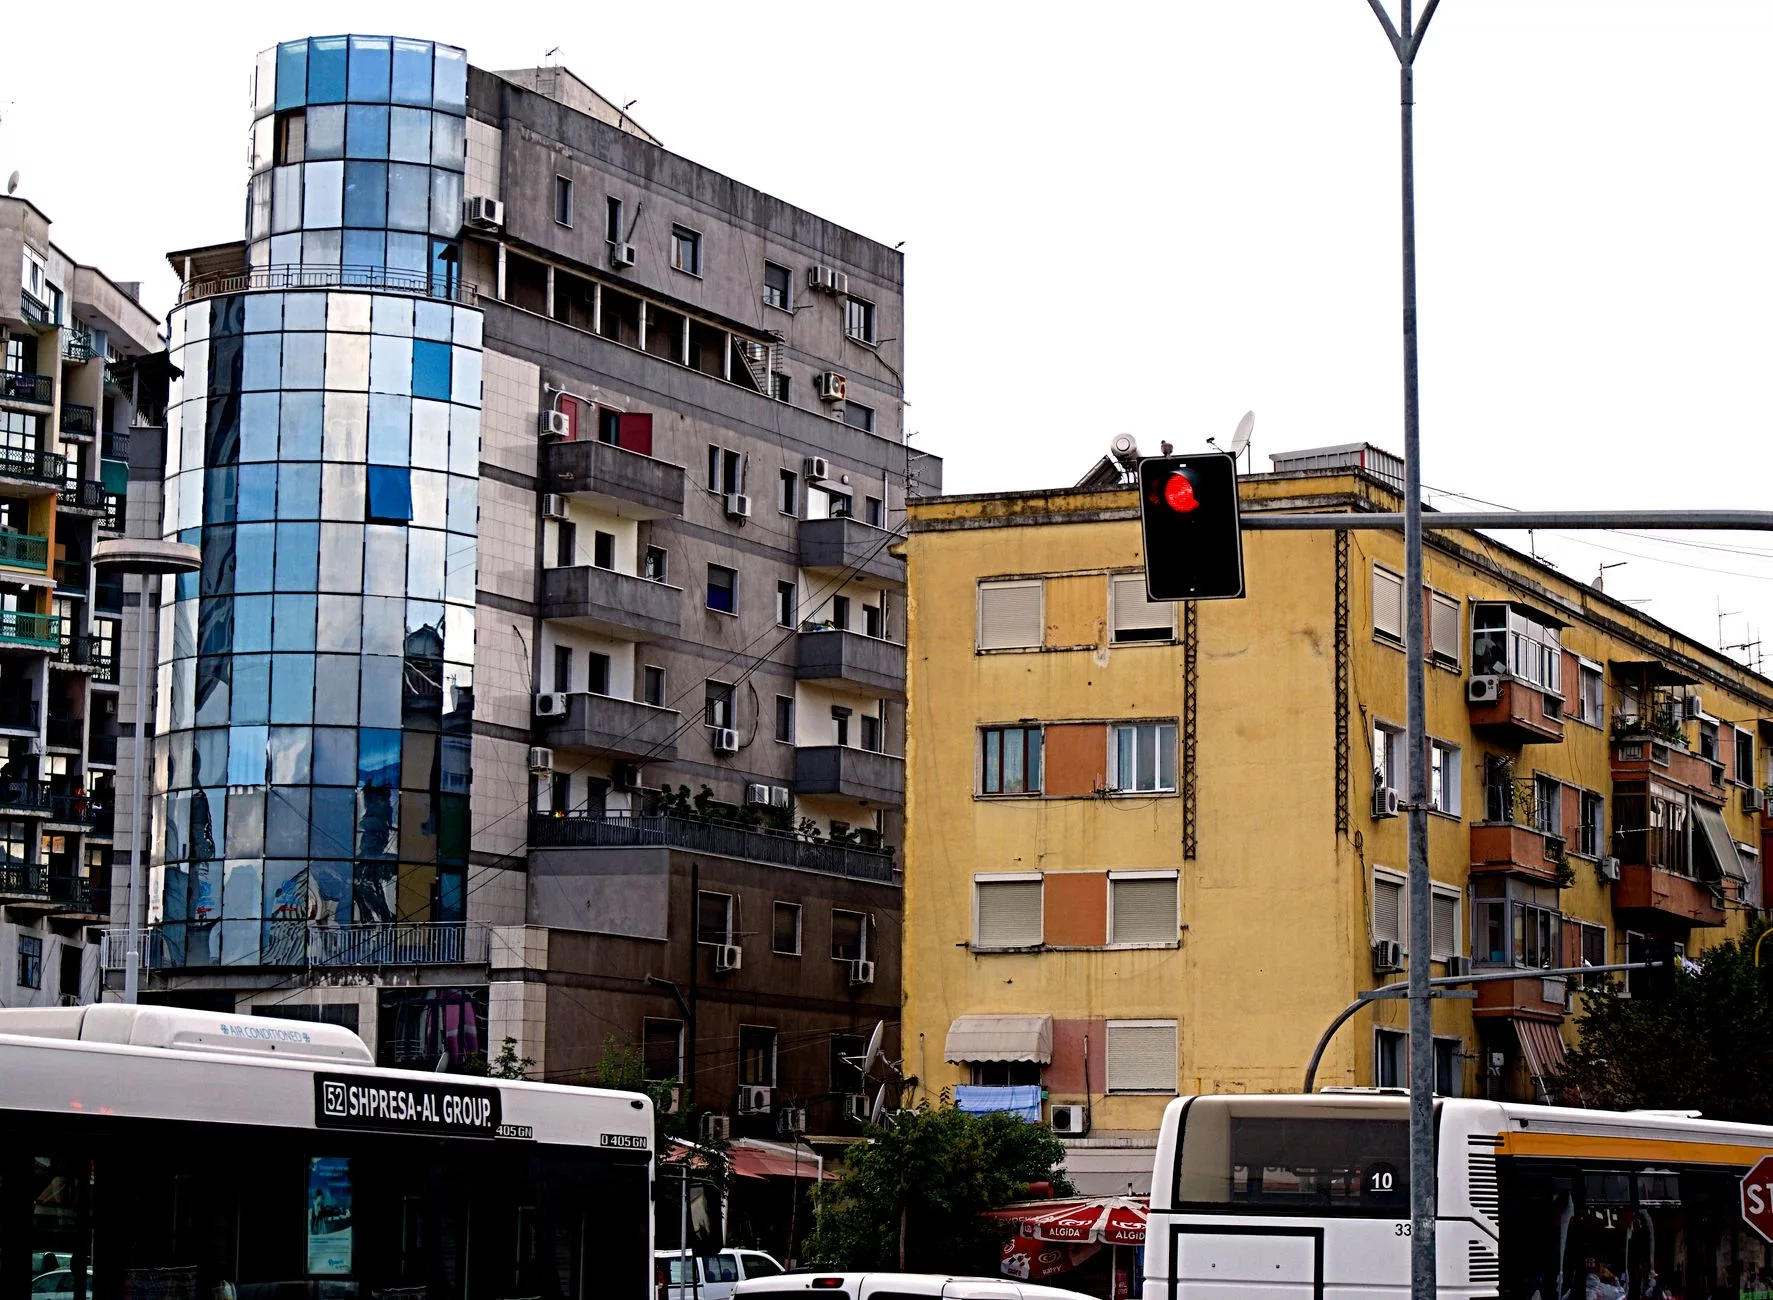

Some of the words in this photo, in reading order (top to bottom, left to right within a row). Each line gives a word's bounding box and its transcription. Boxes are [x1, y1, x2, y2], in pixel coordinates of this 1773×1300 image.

[229, 1025, 245, 1037] AIR
[245, 1026, 303, 1042] CONDITIONED
[327, 1087, 343, 1111] 52
[349, 1086, 440, 1122] SHPRESA-AL
[496, 1125, 517, 1137] 405
[518, 1126, 532, 1137] GN
[610, 1135, 631, 1147] 405
[632, 1136, 647, 1148] GN
[1372, 1172, 1393, 1189] 10
[1115, 1230, 1145, 1240] ALGiD
